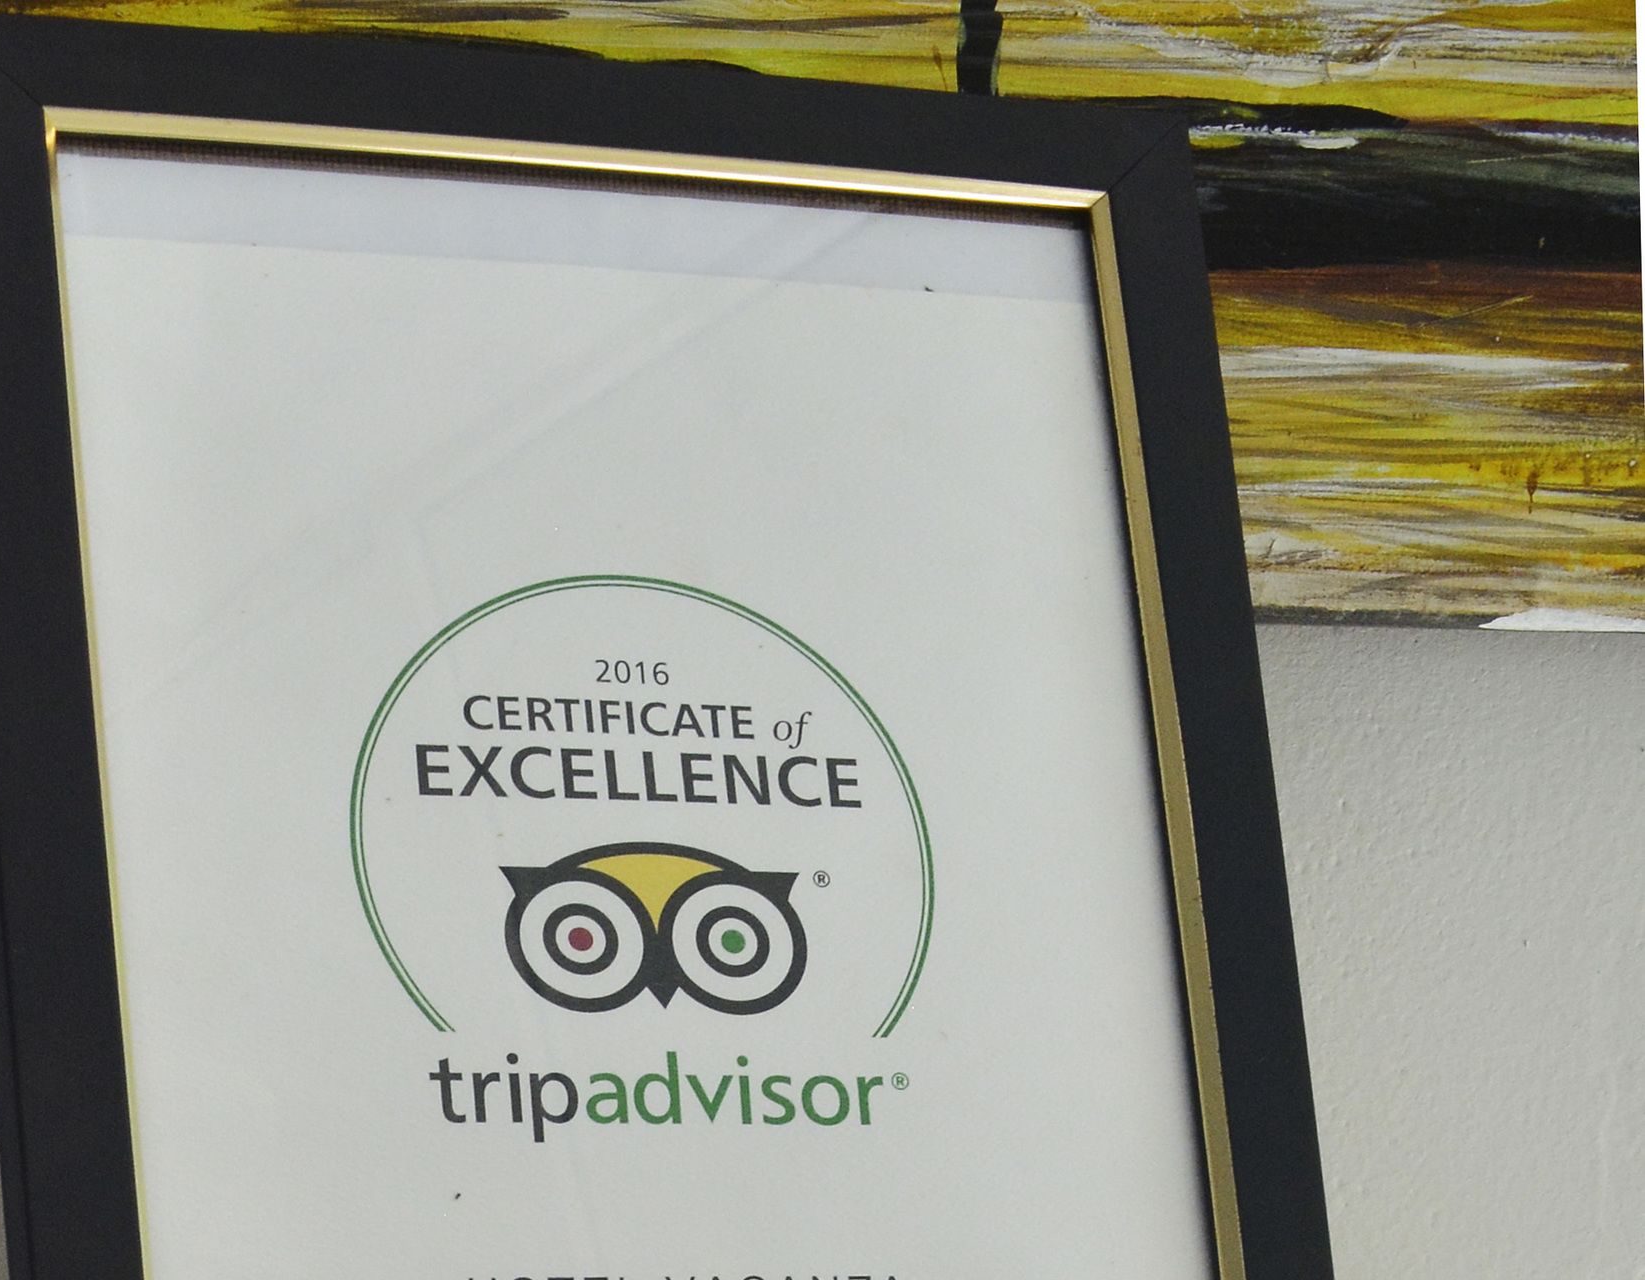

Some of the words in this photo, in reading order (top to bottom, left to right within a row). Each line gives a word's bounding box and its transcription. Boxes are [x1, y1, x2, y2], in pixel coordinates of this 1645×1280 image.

[595, 659, 670, 686] 2016
[462, 694, 756, 739] CERTIFICATE
[772, 711, 813, 749] of
[414, 743, 862, 809] EXCELLENCE
[429, 1050, 885, 1143] tripadvisor
